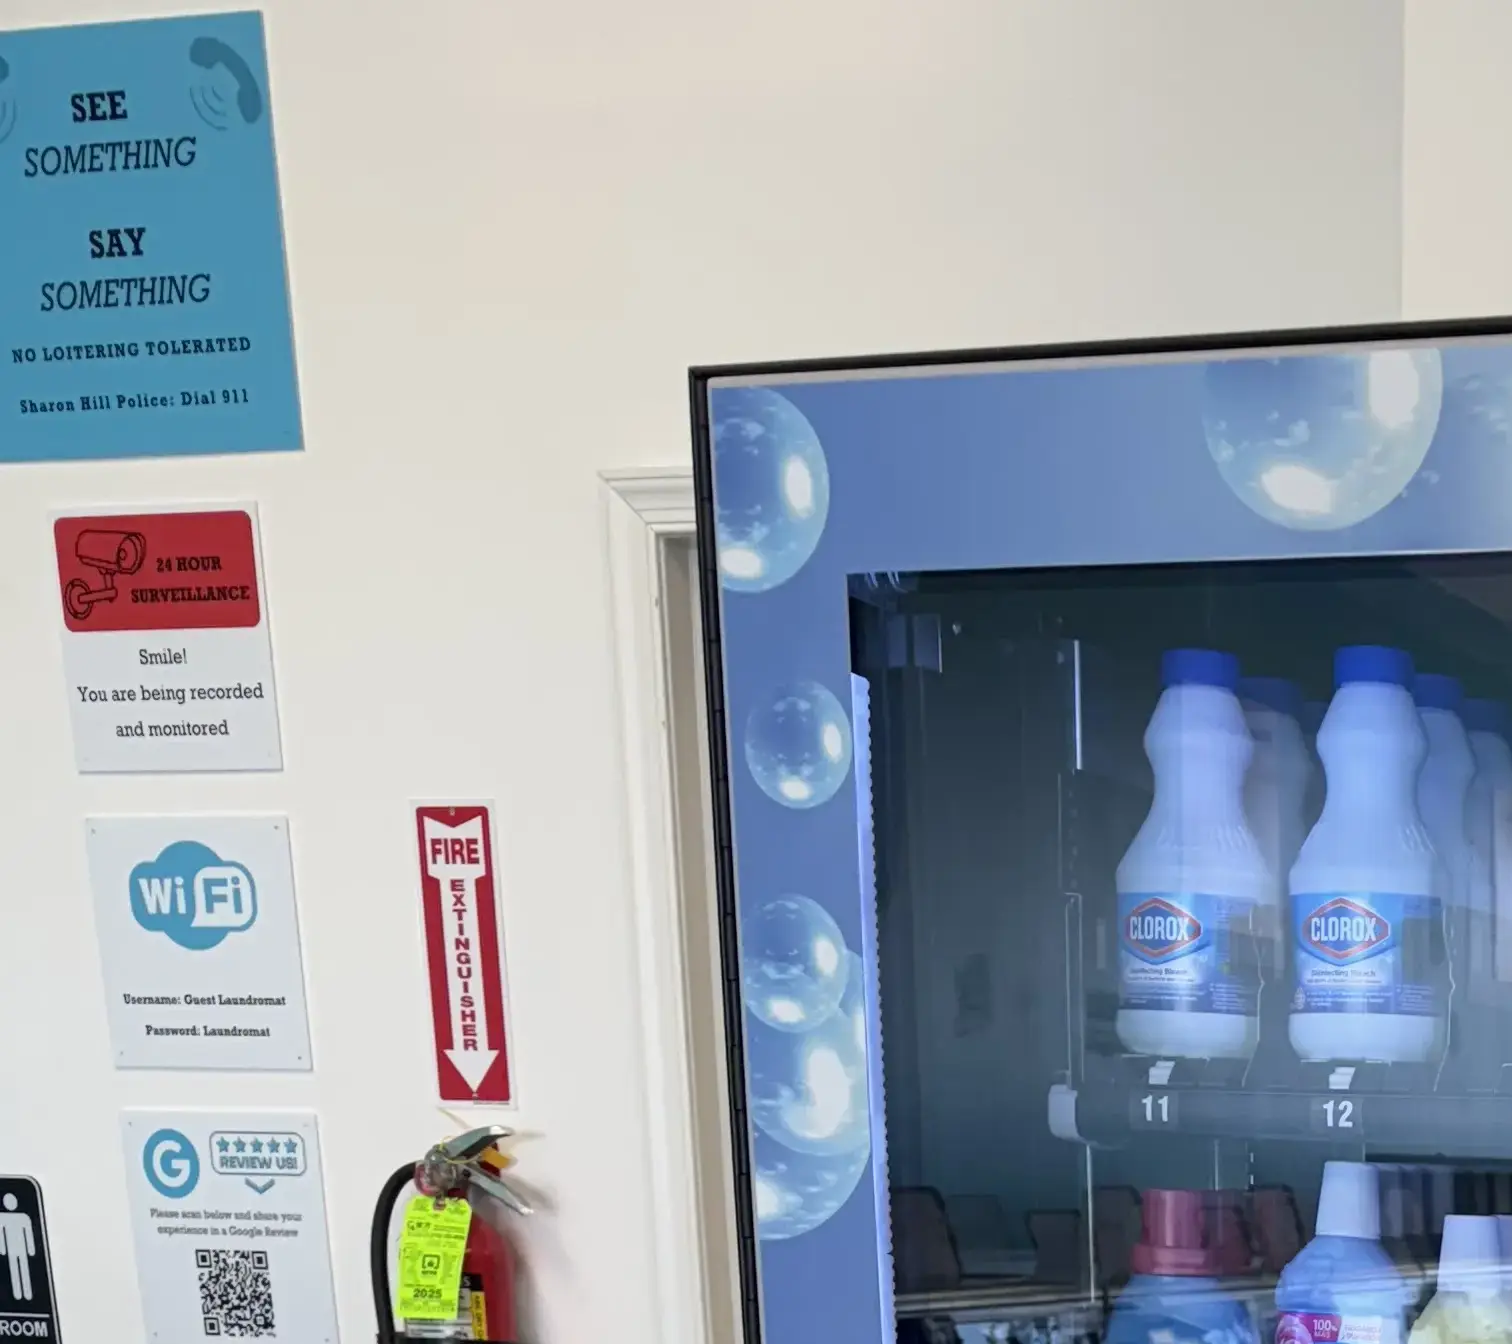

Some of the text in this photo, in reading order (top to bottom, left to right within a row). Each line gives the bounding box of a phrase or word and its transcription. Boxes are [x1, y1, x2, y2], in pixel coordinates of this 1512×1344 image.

[70, 90, 128, 123] SEE
[24, 136, 197, 178] SOMETHING
[89, 227, 146, 259] SAY
[40, 274, 211, 312] SOMETHING
[12, 336, 251, 364] NO LOITERING TOLERATED
[19, 388, 250, 414] Sharon Hill Police: Dial 911
[156, 556, 222, 573] 24 HOUR
[131, 585, 250, 604] SURVEILLANCE
[139, 648, 188, 666] Smile!
[77, 682, 265, 705] You are being recorded
[116, 720, 230, 738] and monitored
[430, 838, 480, 865] FIRE
[1130, 916, 1189, 941] CLOROX
[1311, 916, 1377, 942] CLOROX
[450, 879, 478, 1051] EXTINGUISHER
[123, 994, 286, 1006] Username: Guest Laundromat
[145, 1025, 271, 1037] Password: Laundromat
[1141, 1095, 1170, 1123] 11
[1322, 1100, 1354, 1128] 12
[220, 1156, 298, 1170] REVIEW US!
[150, 1208, 180, 1219] Please
[204, 1209, 231, 1220] below
[234, 1211, 251, 1220] and
[281, 1213, 302, 1223] your
[157, 1225, 208, 1236] experience
[211, 1226, 219, 1235] in
[229, 1226, 263, 1238] Google
[413, 1288, 442, 1299] 2025
